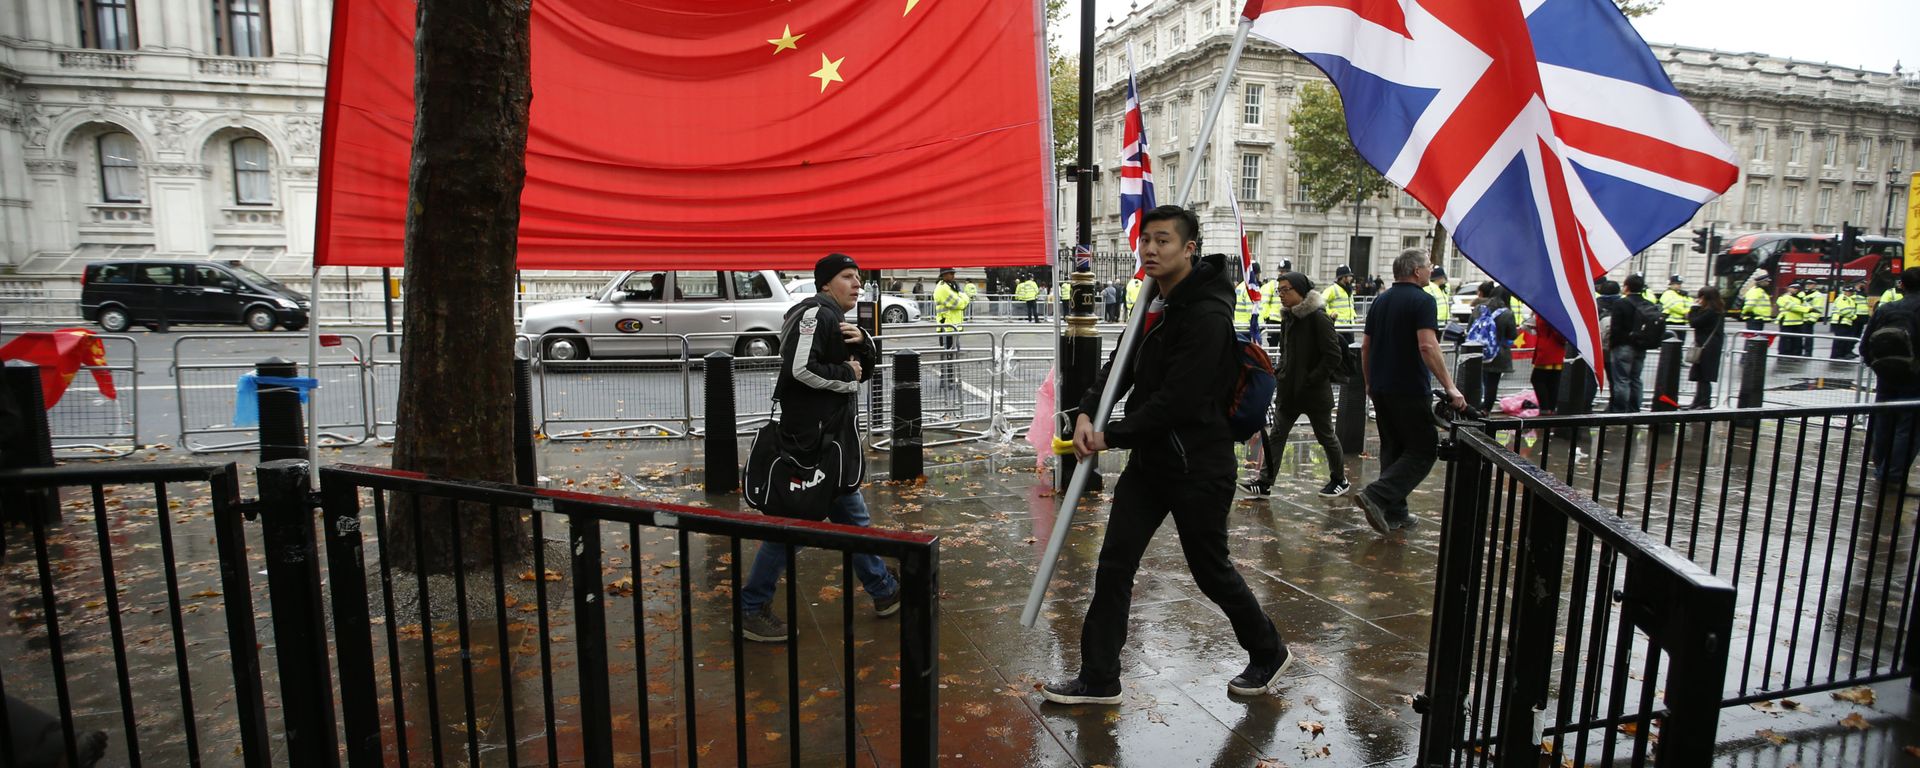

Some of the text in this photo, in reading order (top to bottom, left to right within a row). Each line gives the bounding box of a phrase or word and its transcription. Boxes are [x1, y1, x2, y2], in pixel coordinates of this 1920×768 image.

[1795, 267, 1808, 275] THE
[1808, 267, 1838, 276] AMERIC
[790, 469, 826, 491] FILA
